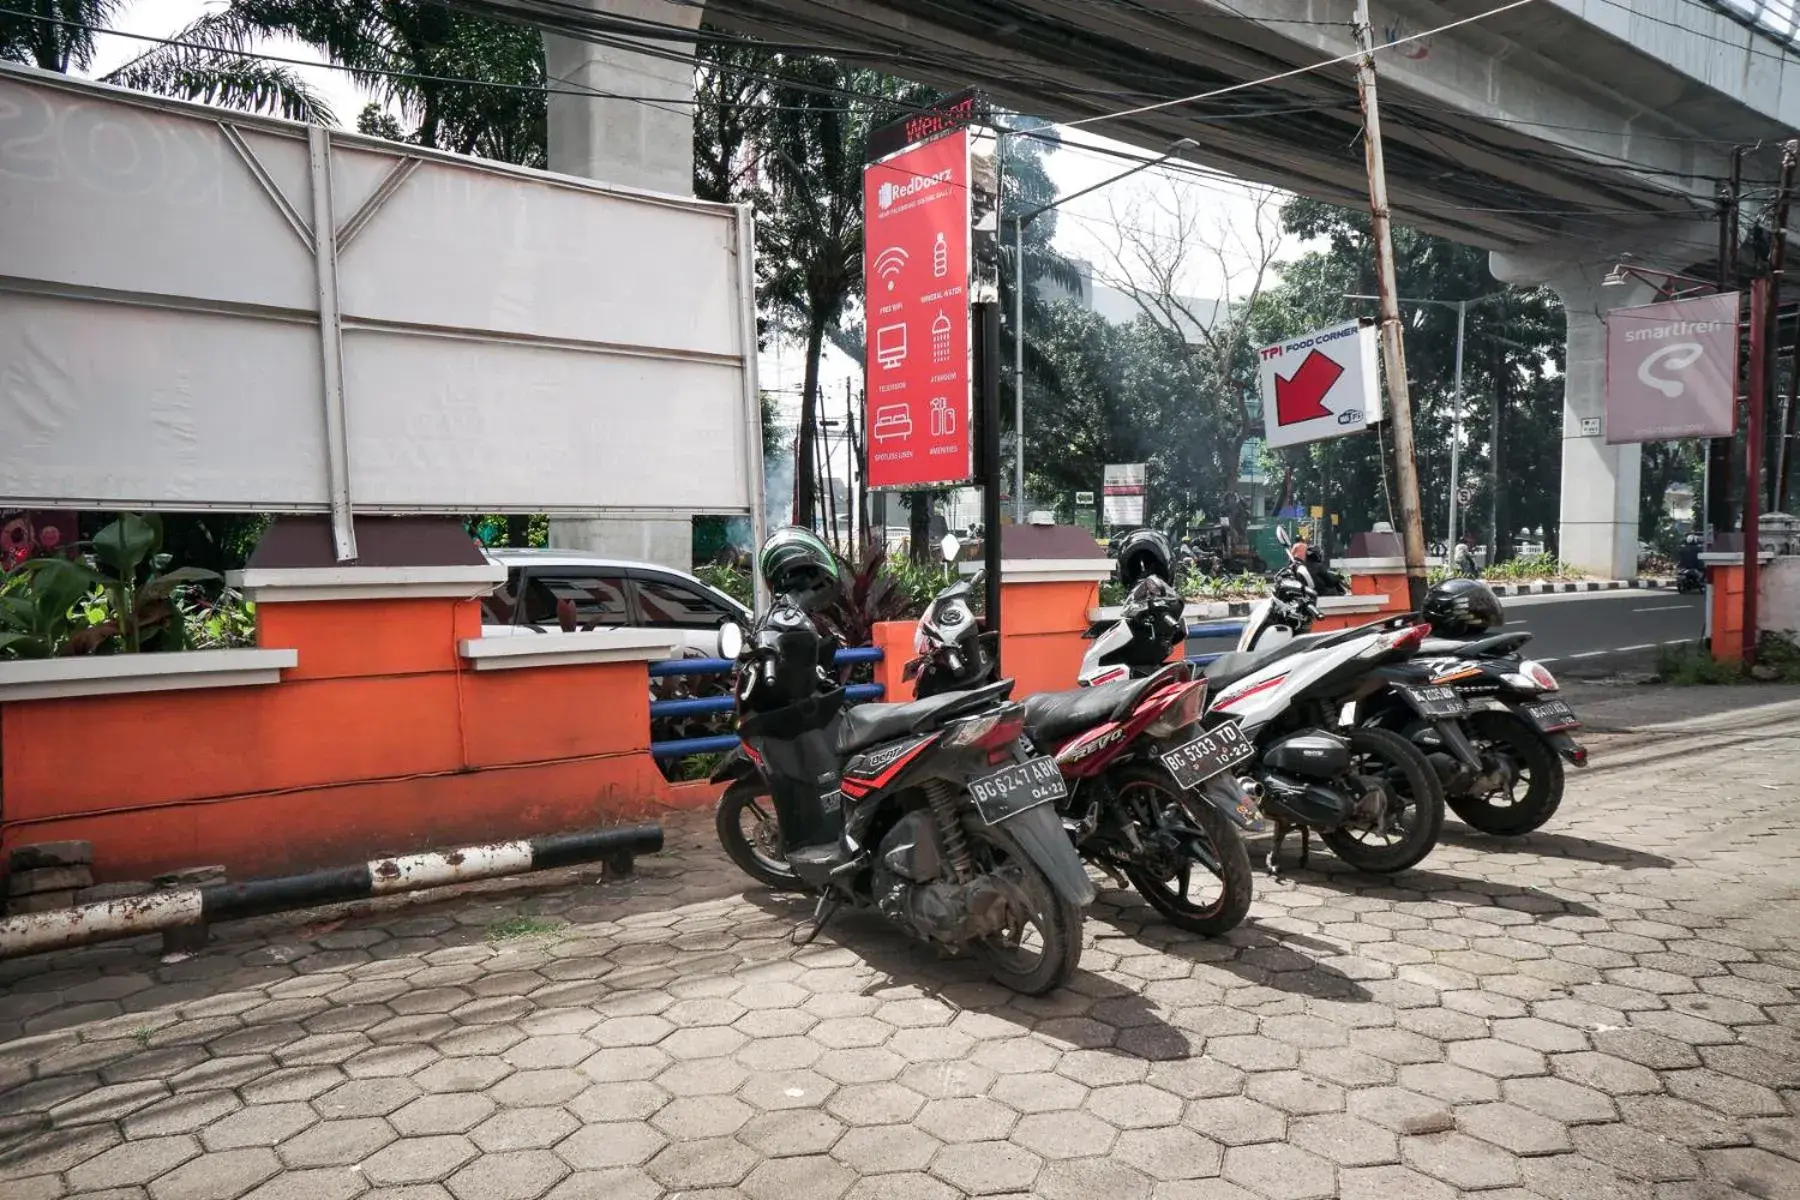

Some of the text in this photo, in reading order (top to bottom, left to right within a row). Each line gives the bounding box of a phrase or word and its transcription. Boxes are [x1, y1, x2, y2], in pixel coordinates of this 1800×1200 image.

[892, 168, 952, 200] RedDoorz
[880, 304, 892, 314] FREE
[1261, 326, 1359, 360] TPI FOOD CORNER
[1624, 320, 1722, 343] smartfren
[1166, 726, 1237, 771] BG 5333 TD
[973, 759, 1059, 801] BG 6247 ABK
